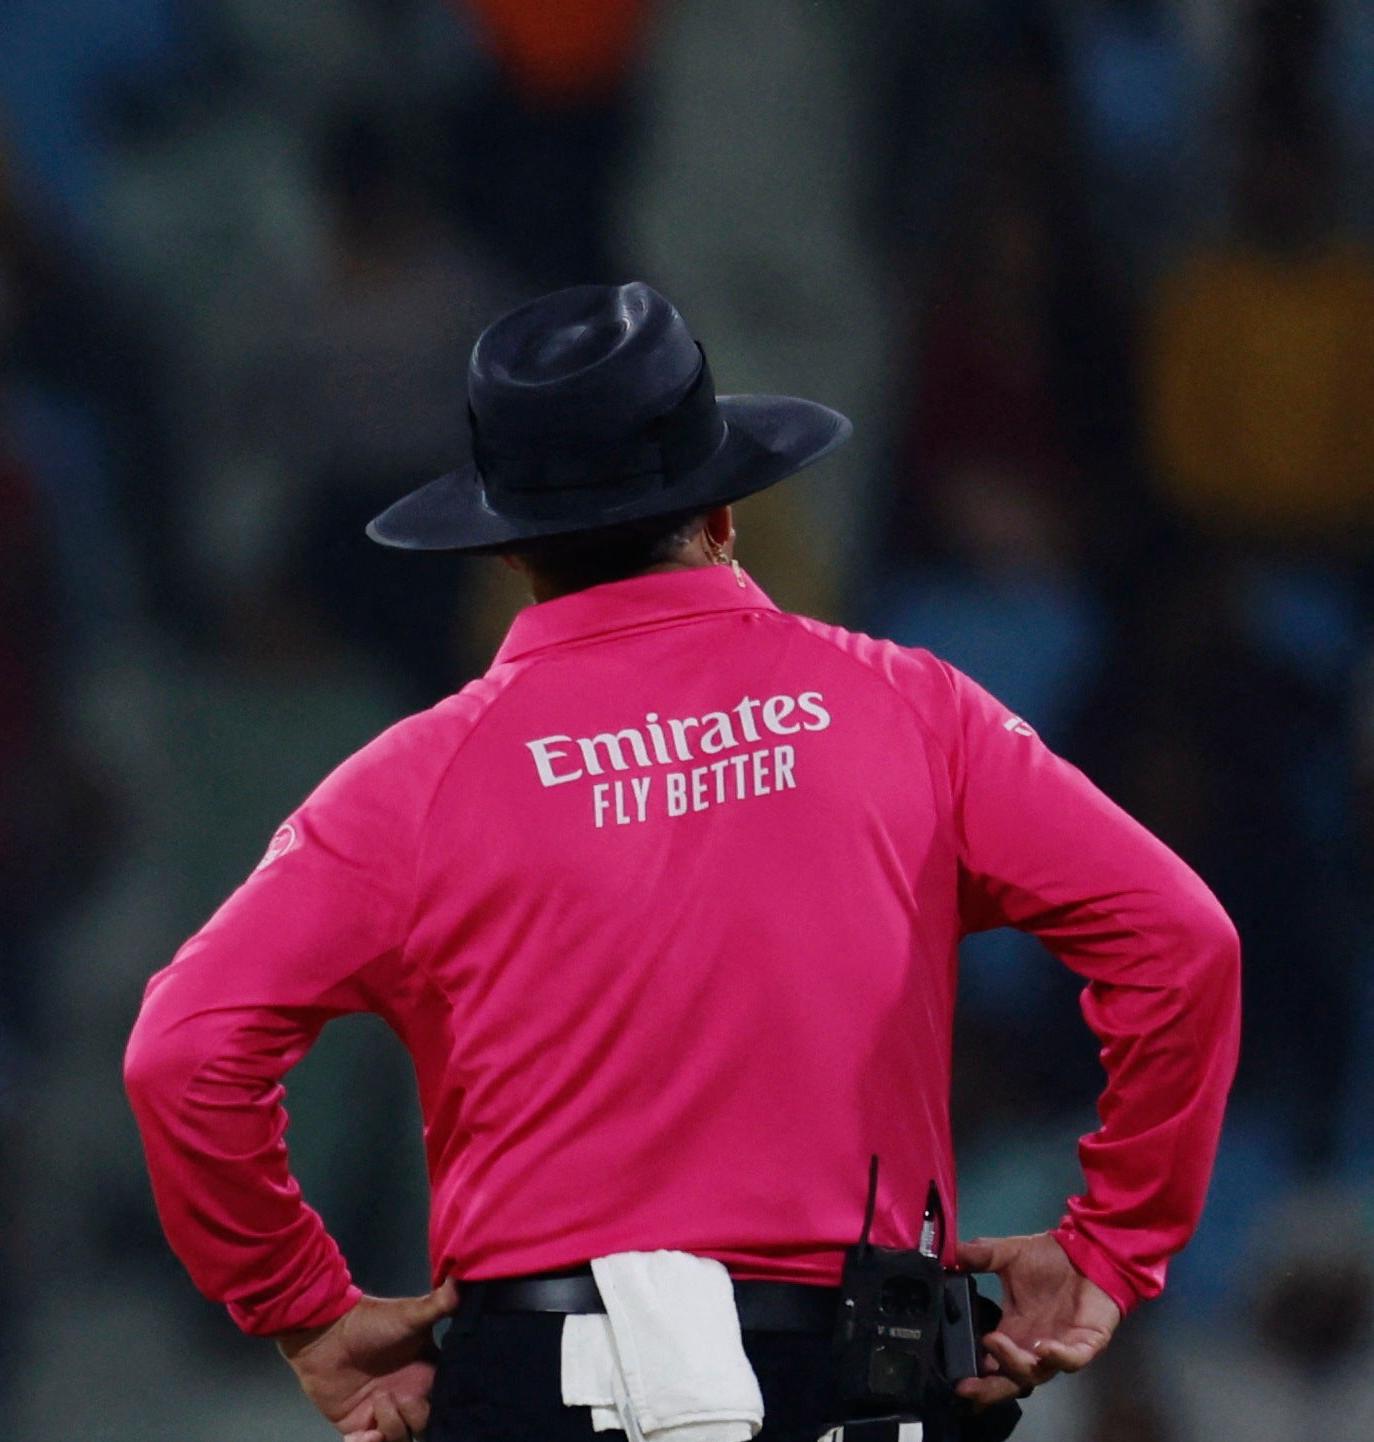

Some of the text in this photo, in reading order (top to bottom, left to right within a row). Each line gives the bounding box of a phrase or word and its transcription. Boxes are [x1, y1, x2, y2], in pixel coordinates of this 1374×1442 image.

[525, 691, 831, 787] Emirates
[593, 745, 796, 828] FLY BETTER
